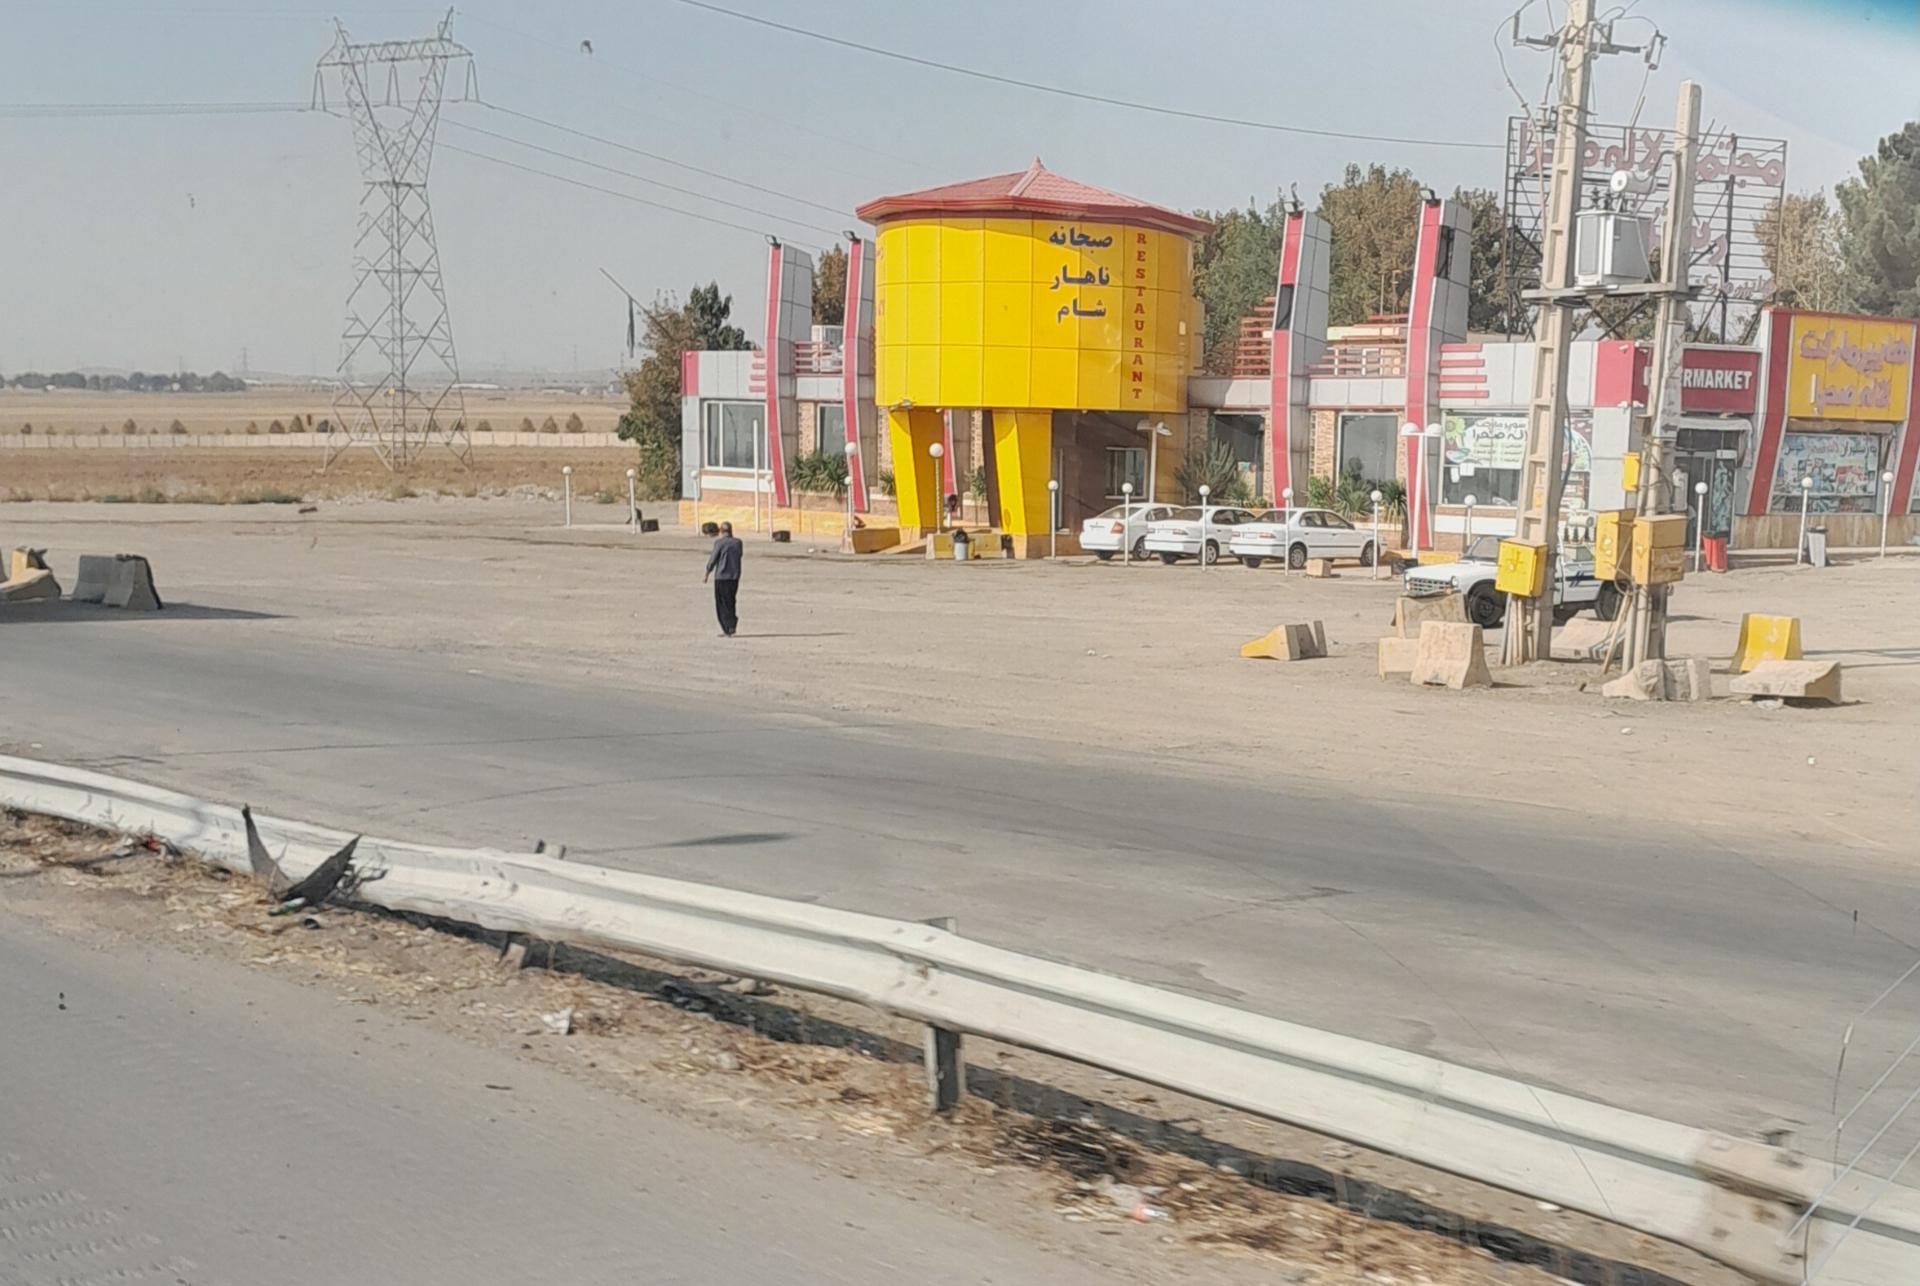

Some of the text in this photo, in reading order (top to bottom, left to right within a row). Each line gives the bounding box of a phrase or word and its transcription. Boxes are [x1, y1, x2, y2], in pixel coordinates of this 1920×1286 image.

[1049, 226, 1113, 254] صبحانه
[1050, 265, 1110, 289] ناهار
[1057, 299, 1107, 323] شام
[1132, 232, 1147, 399] RESTAURANT
